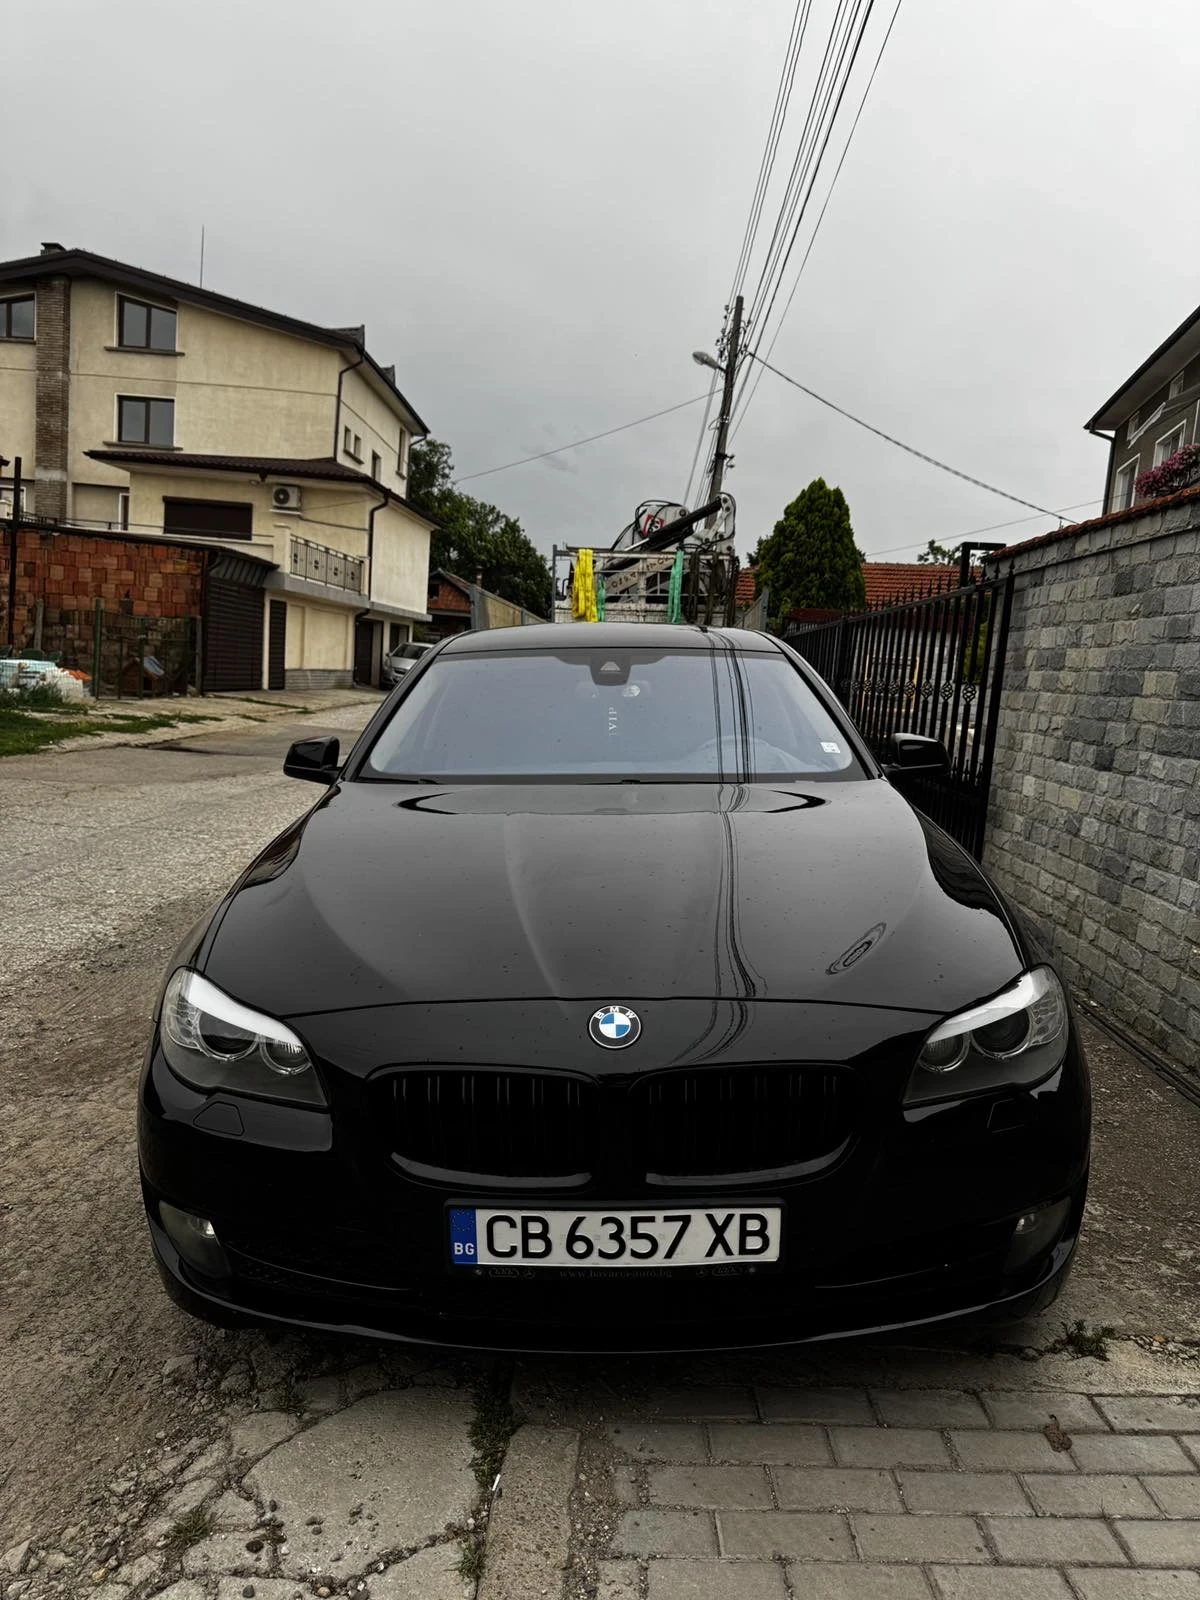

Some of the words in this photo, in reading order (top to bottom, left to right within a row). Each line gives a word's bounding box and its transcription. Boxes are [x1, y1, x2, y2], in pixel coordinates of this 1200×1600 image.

[594, 1006, 637, 1020] BMW
[486, 1214, 553, 1259] CB
[566, 1214, 692, 1260] 6357
[704, 1213, 770, 1258] XB
[454, 1243, 475, 1255] BG
